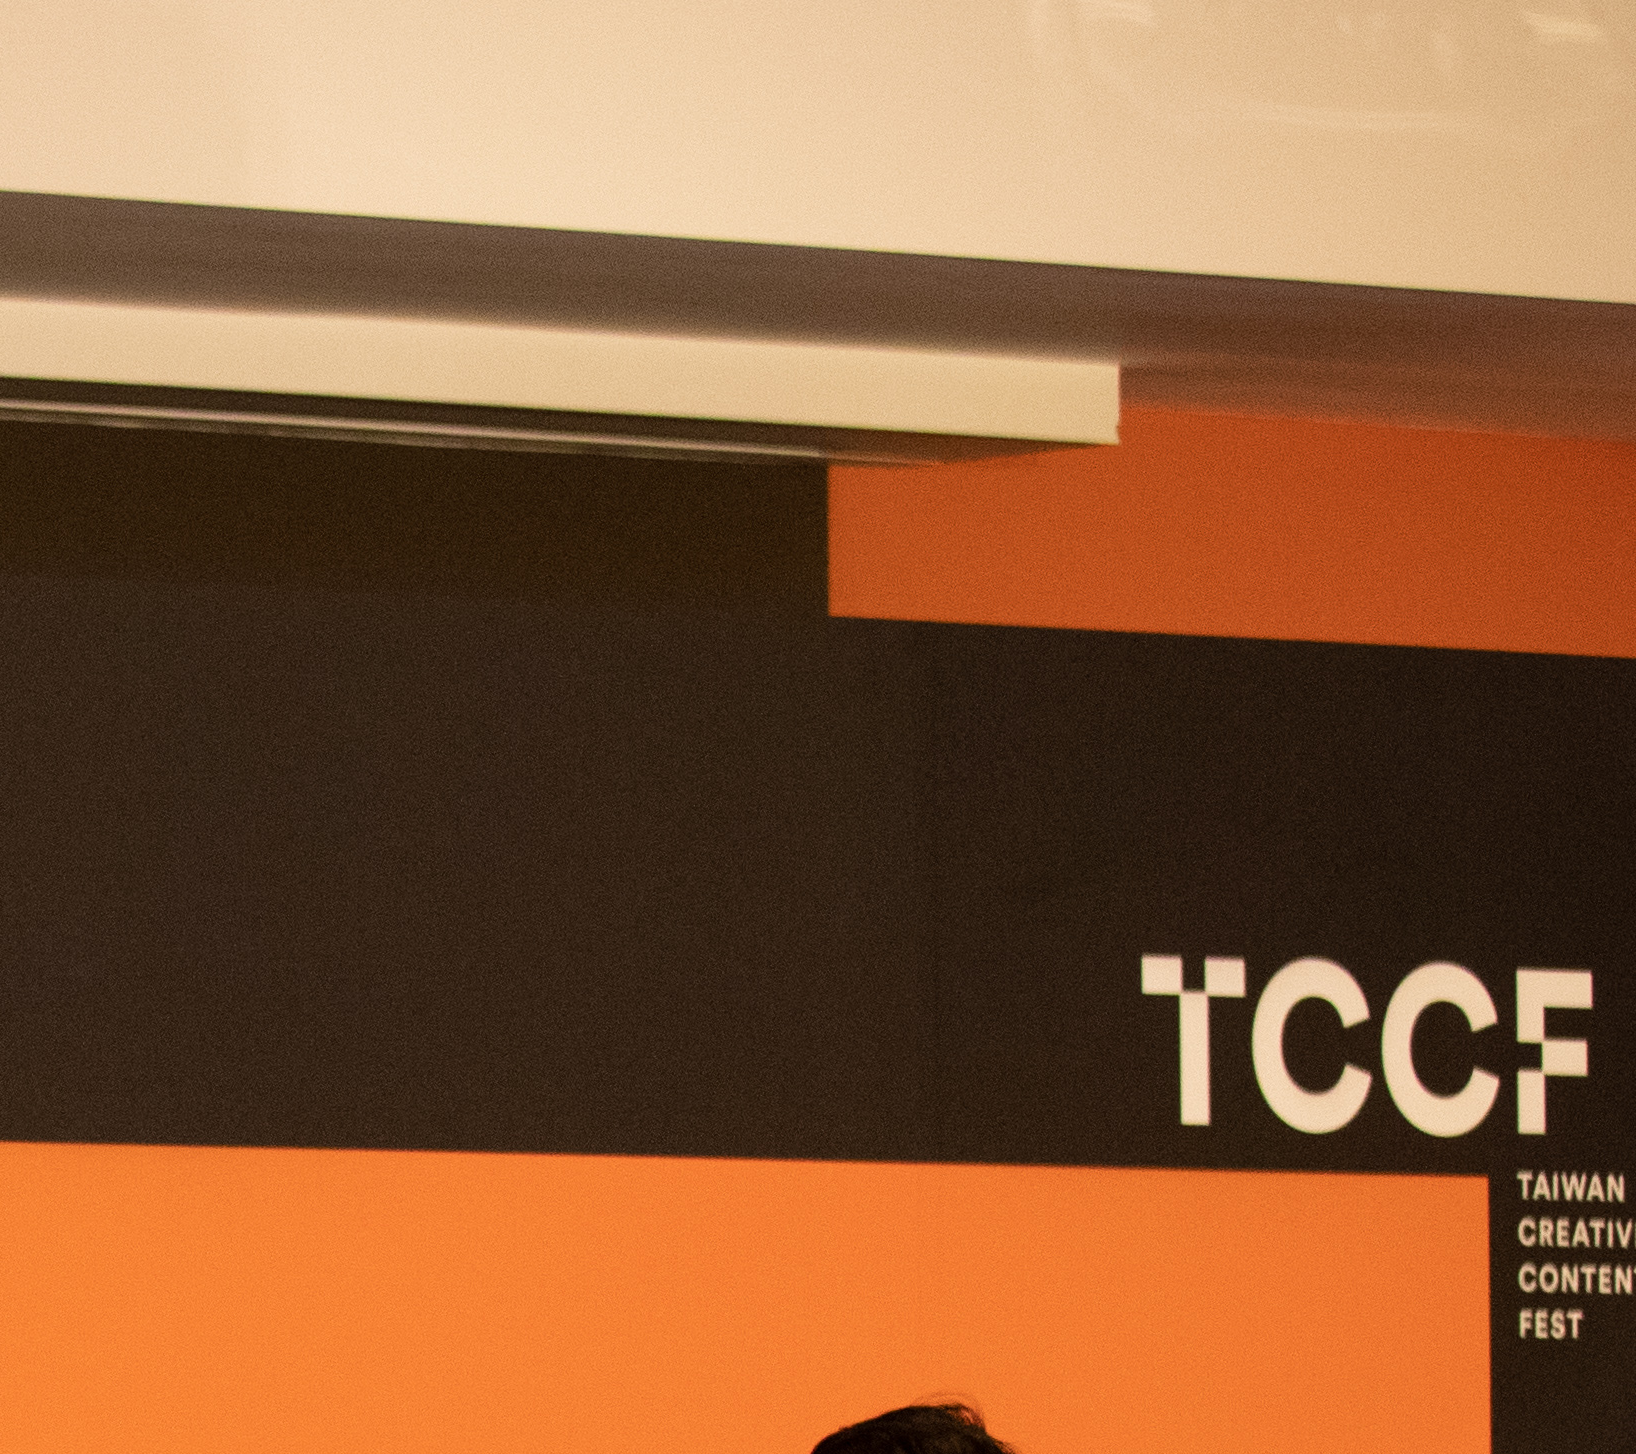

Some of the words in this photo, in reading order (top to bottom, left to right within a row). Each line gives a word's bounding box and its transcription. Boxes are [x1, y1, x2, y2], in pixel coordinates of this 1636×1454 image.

[1141, 954, 1593, 1138] TCCF
[1517, 1170, 1625, 1202] TAIWAN
[1517, 1215, 1636, 1249] CREATIV
[1517, 1262, 1636, 1295] CONTEN
[1519, 1307, 1584, 1340] FEST
